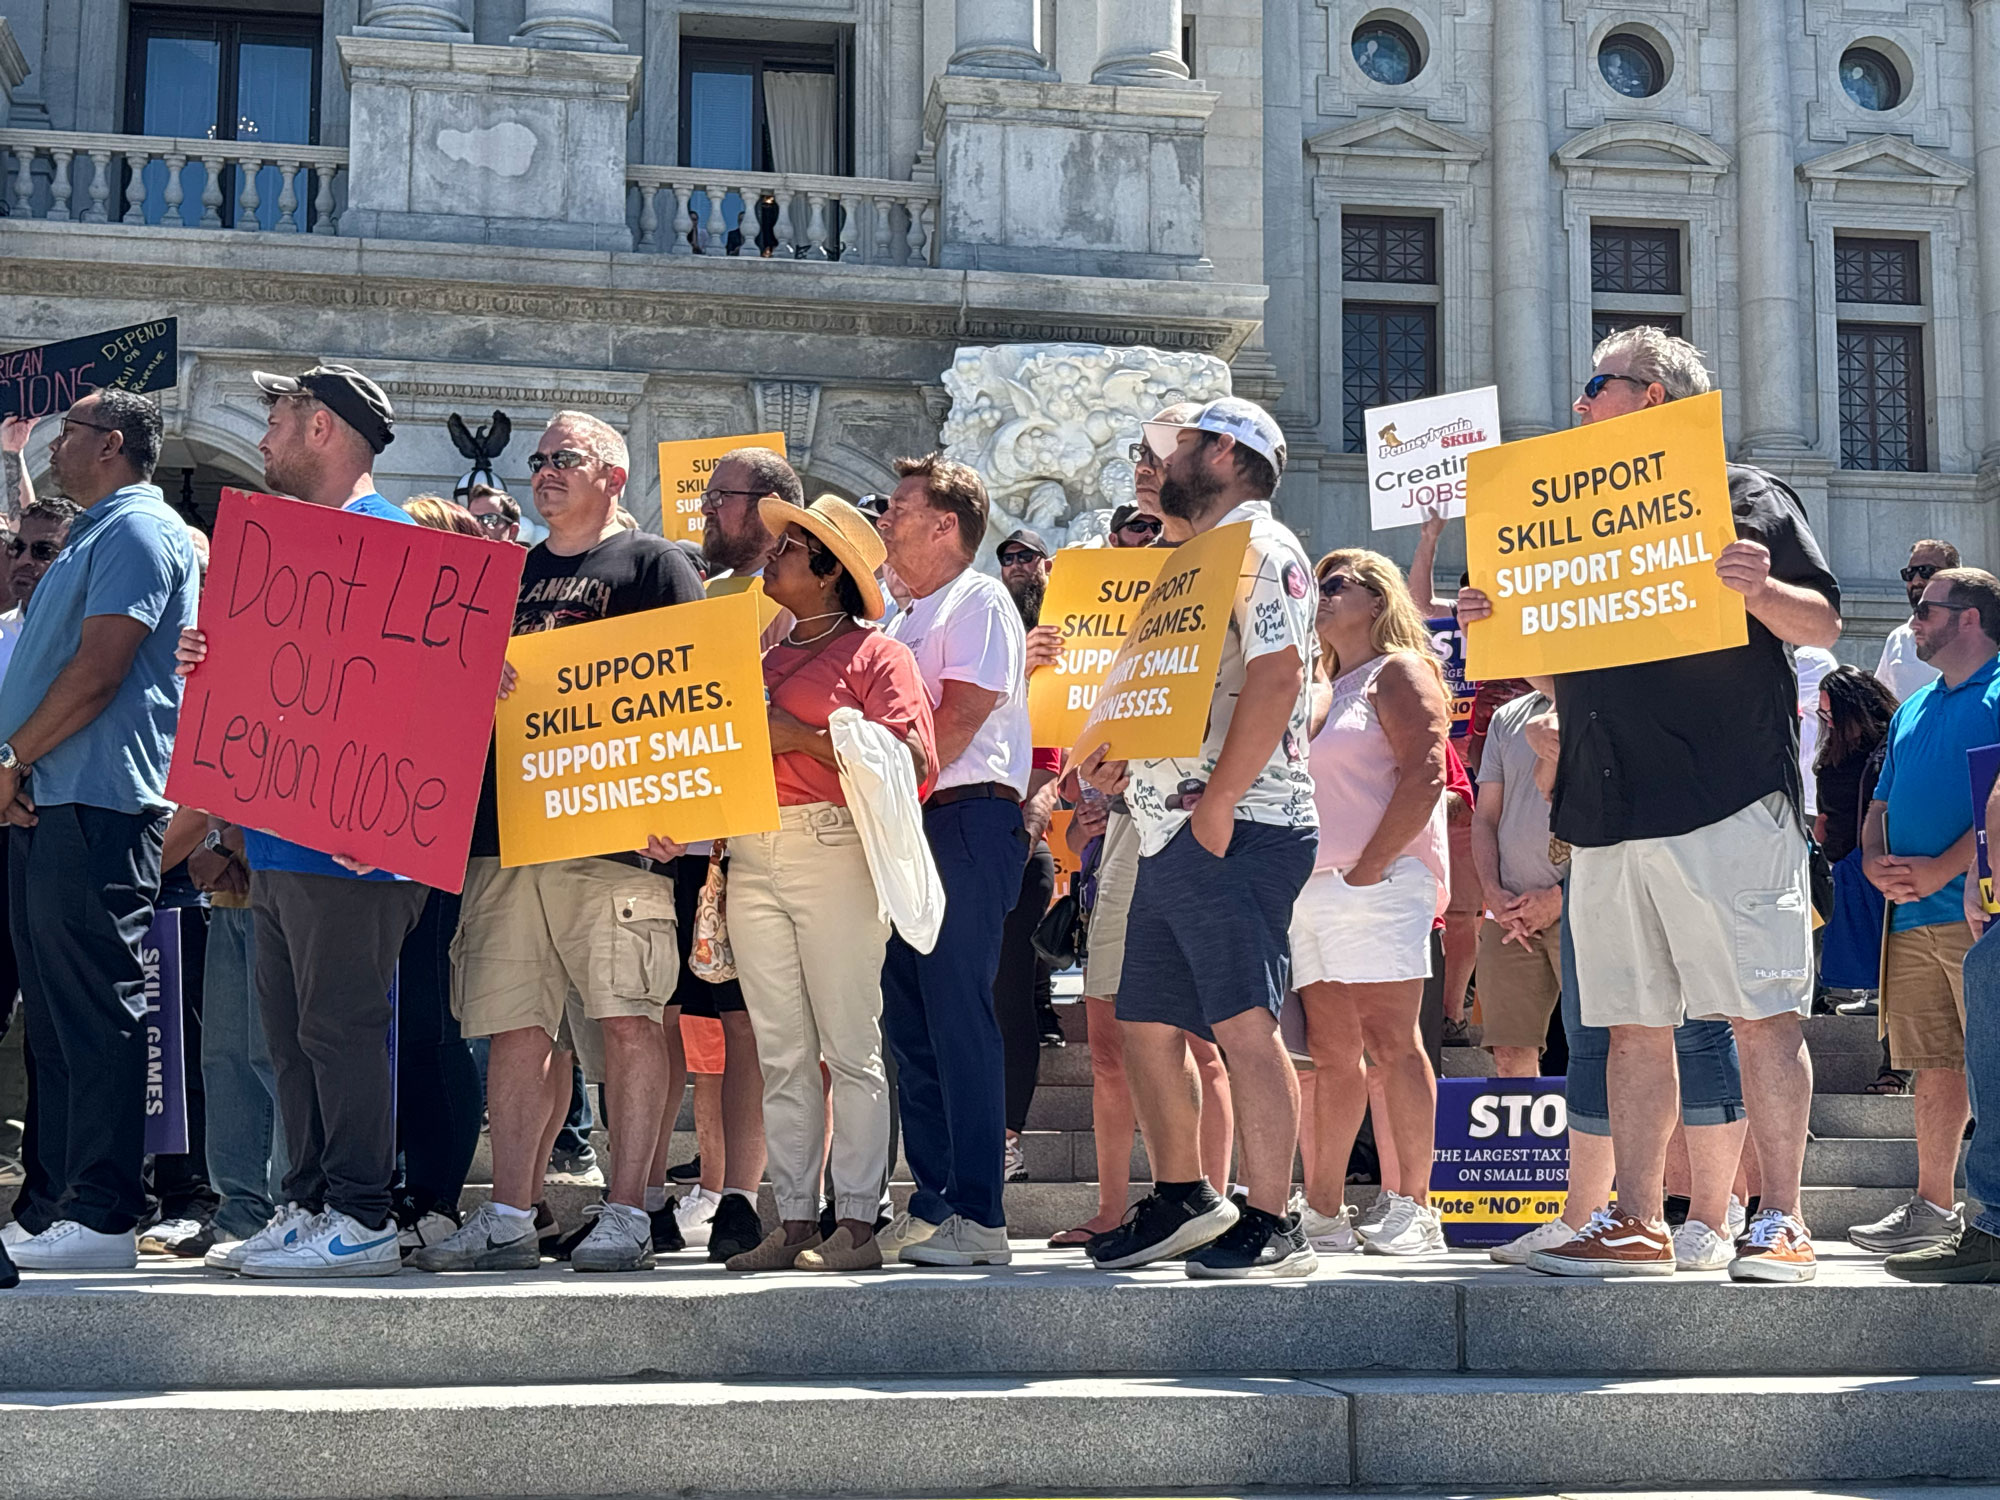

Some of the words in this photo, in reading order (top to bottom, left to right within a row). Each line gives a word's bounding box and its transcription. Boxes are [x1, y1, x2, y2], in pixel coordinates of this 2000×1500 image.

[101, 322, 167, 361] DEPEND
[1378, 417, 1473, 460] Pennsylvania
[1440, 428, 1488, 449] SKILL
[1401, 480, 1467, 509] JOBS
[1531, 450, 1667, 507] SUPPORT
[1497, 516, 1583, 555] SKILL
[1591, 489, 1702, 538] GAMES.
[1496, 549, 1623, 598] SUPPORT
[1629, 531, 1714, 577] SMALL
[229, 519, 367, 635] Don't
[381, 545, 491, 669] Let
[1521, 580, 1697, 636] BUSINESSES.
[1062, 613, 1128, 638] SKILL
[1138, 604, 1206, 644] GAMES.
[557, 644, 695, 694] SUPPORT
[1139, 644, 1200, 679] SMALL
[524, 702, 603, 740] SKILL
[611, 681, 733, 724] GAMES.
[521, 735, 642, 782] SUPPORT
[649, 721, 743, 763] SMALL
[544, 767, 723, 819] BUSINESSES.
[145, 1026, 164, 1116] GAMES
[1468, 1094, 1568, 1138] STO
[1432, 1149, 1461, 1162] THE
[1464, 1149, 1530, 1162] LARGEST
[1530, 1149, 1562, 1161] TAX
[1458, 1169, 1482, 1182] ON
[1483, 1168, 1532, 1182] SMALL
[1430, 1197, 1475, 1214] Vote
[1535, 1200, 1560, 1215] on
